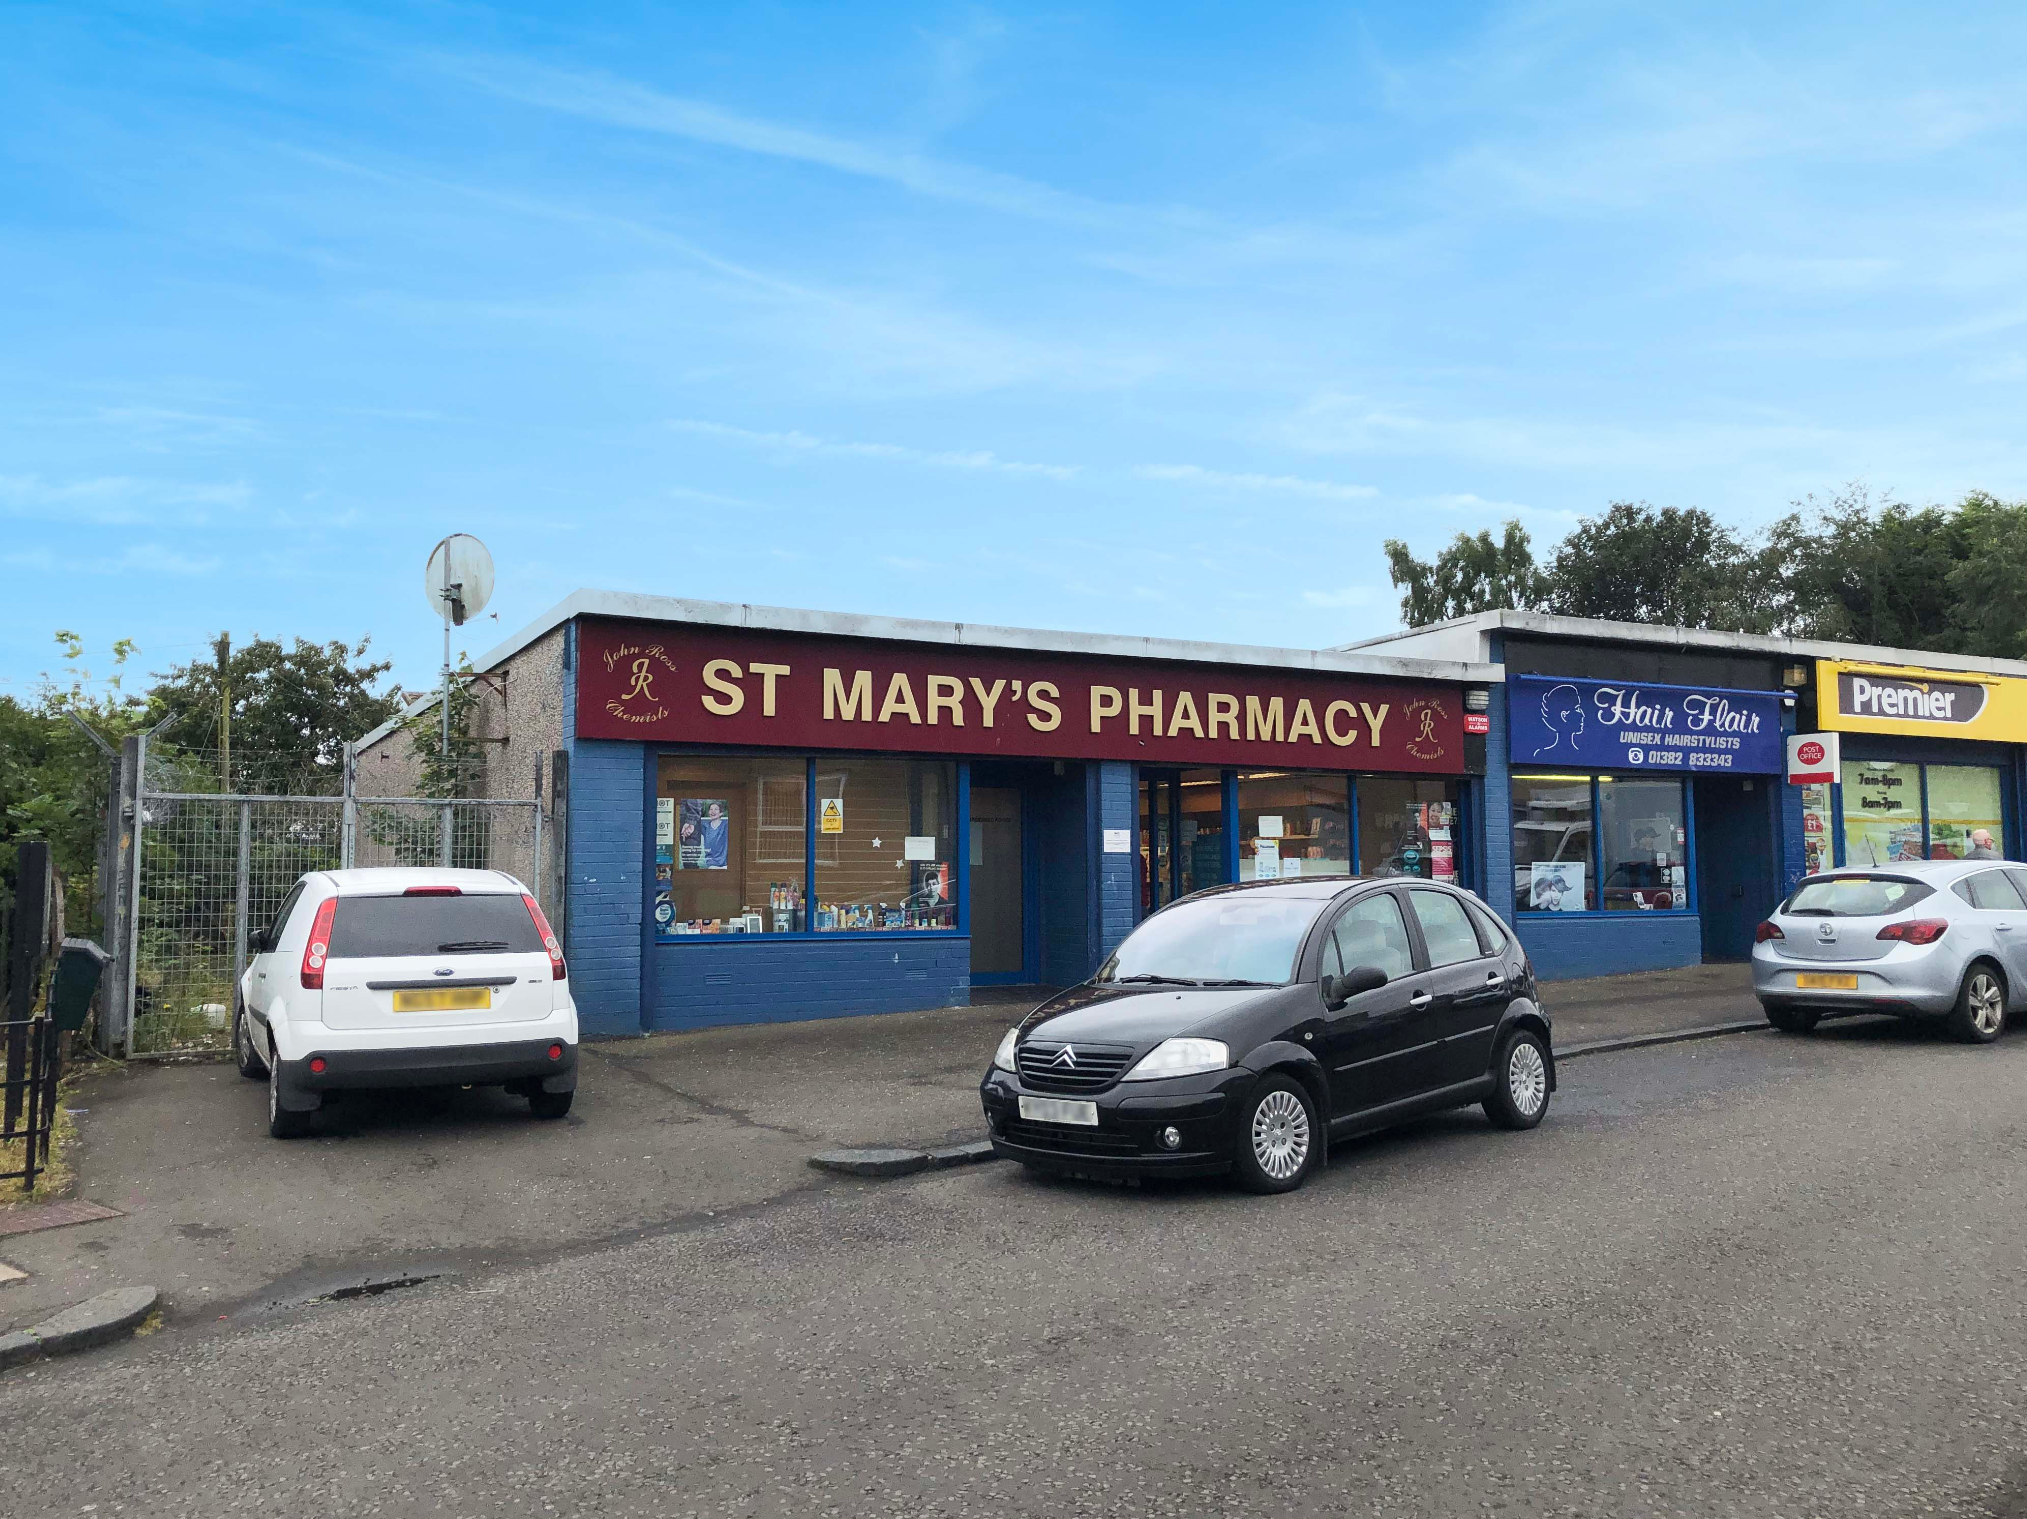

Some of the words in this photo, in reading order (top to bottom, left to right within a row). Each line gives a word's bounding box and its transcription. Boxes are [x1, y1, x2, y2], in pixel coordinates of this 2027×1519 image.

[603, 643, 641, 673] John
[645, 644, 679, 672] Ross
[701, 659, 790, 717] ST
[823, 668, 1062, 732] MARY'S
[1090, 685, 1390, 747] PHARMACY
[1403, 698, 1425, 720] John
[1428, 698, 1448, 720] Ross
[1852, 678, 1955, 718] Premier
[606, 699, 670, 723] Chemists
[1594, 687, 1674, 729] Hair
[1683, 694, 1761, 734] Flair
[1406, 741, 1444, 760] Chemists
[1620, 731, 1661, 745] UNISEX
[1665, 734, 1741, 749] HAIRSTYLISTS
[1648, 750, 1683, 765] 01382
[1689, 752, 1733, 767] 833343
